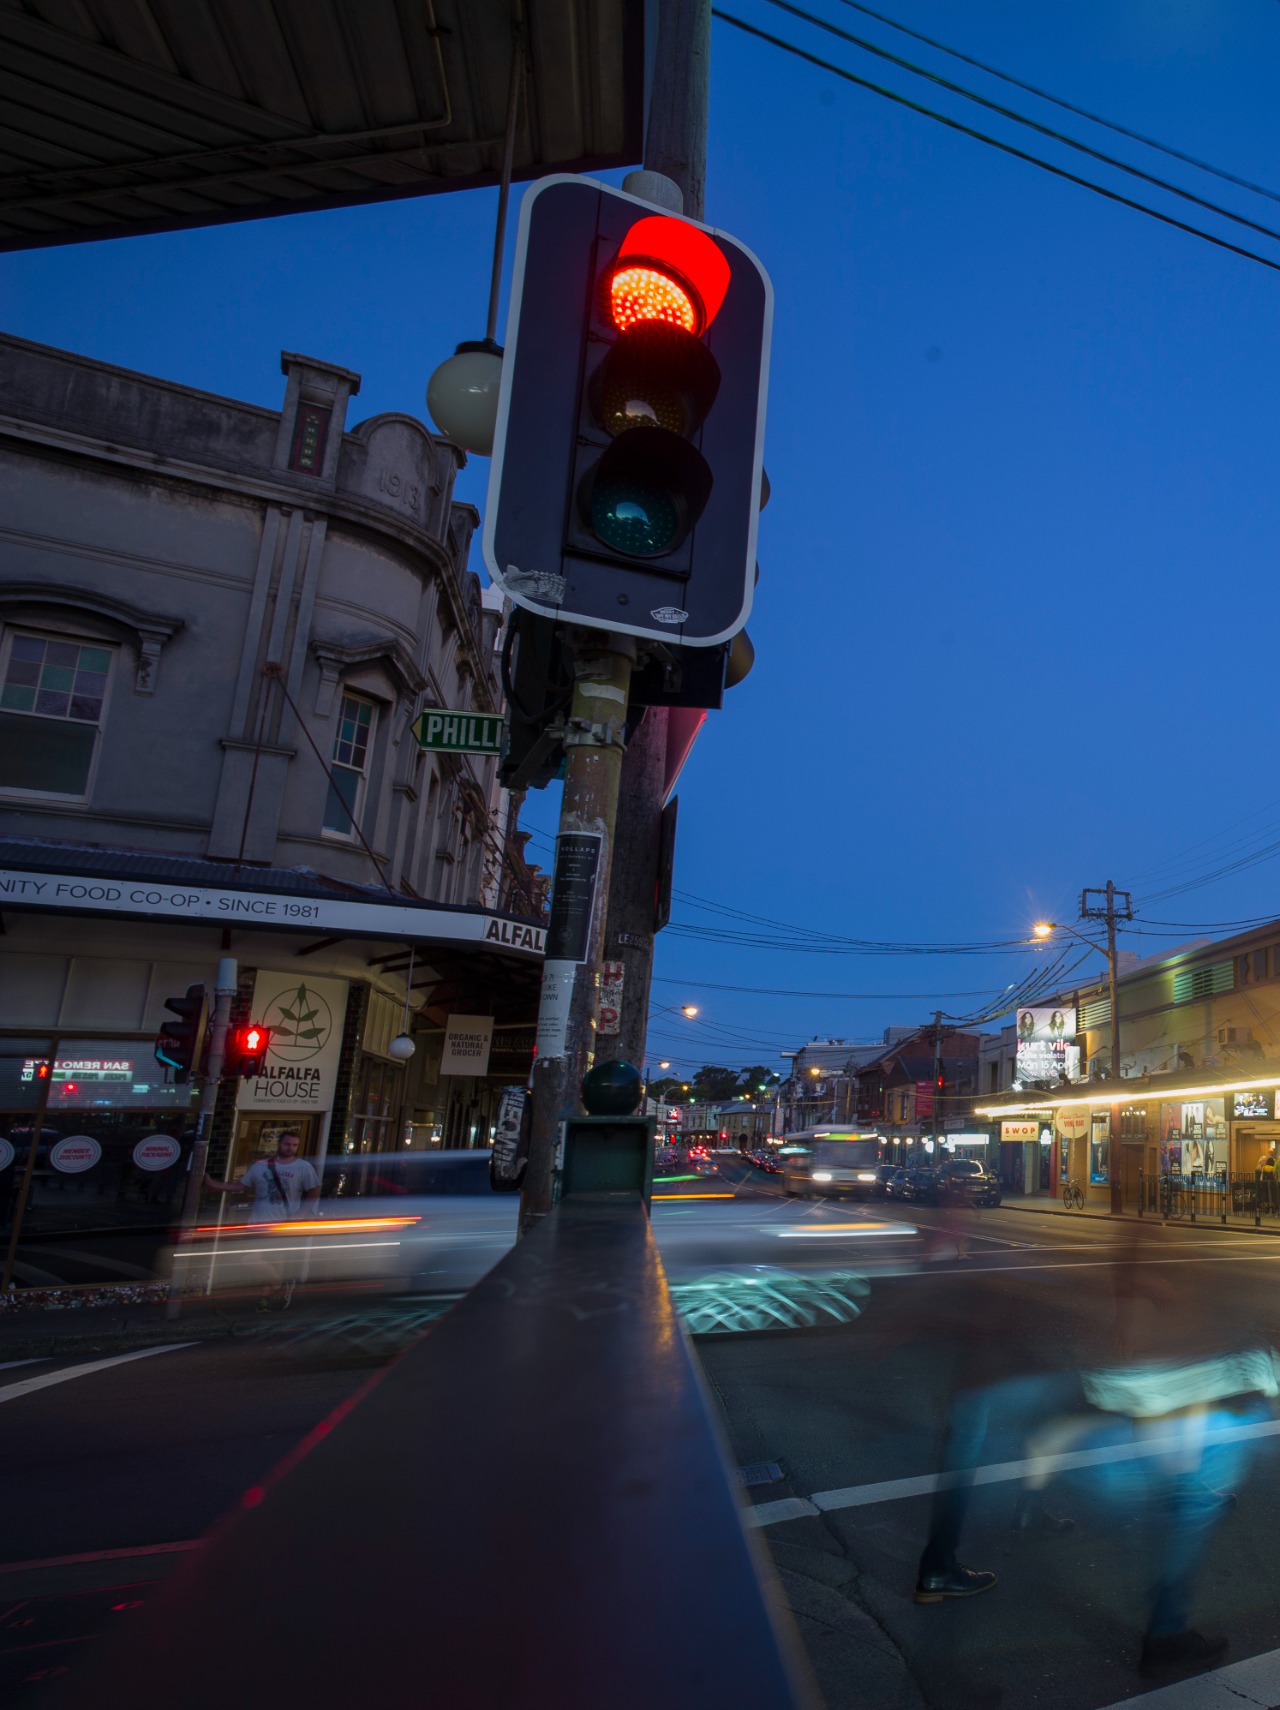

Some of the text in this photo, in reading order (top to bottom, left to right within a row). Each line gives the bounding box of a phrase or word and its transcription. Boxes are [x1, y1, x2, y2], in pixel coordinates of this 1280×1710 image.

[56, 884, 121, 901] FOOD
[130, 890, 200, 907] CO-OP
[218, 898, 277, 915] SINCE
[282, 904, 319, 918] 1981
[448, 1033, 484, 1042] ORGANIC
[451, 1041, 484, 1050] NATURAL
[1017, 1039, 1046, 1051] kurt
[451, 1049, 482, 1057] GROCER
[1017, 1060, 1037, 1069] Mon
[1040, 1061, 1050, 1069] 15
[260, 1066, 320, 1081] ALFALFA
[254, 1080, 320, 1098] HOUSE
